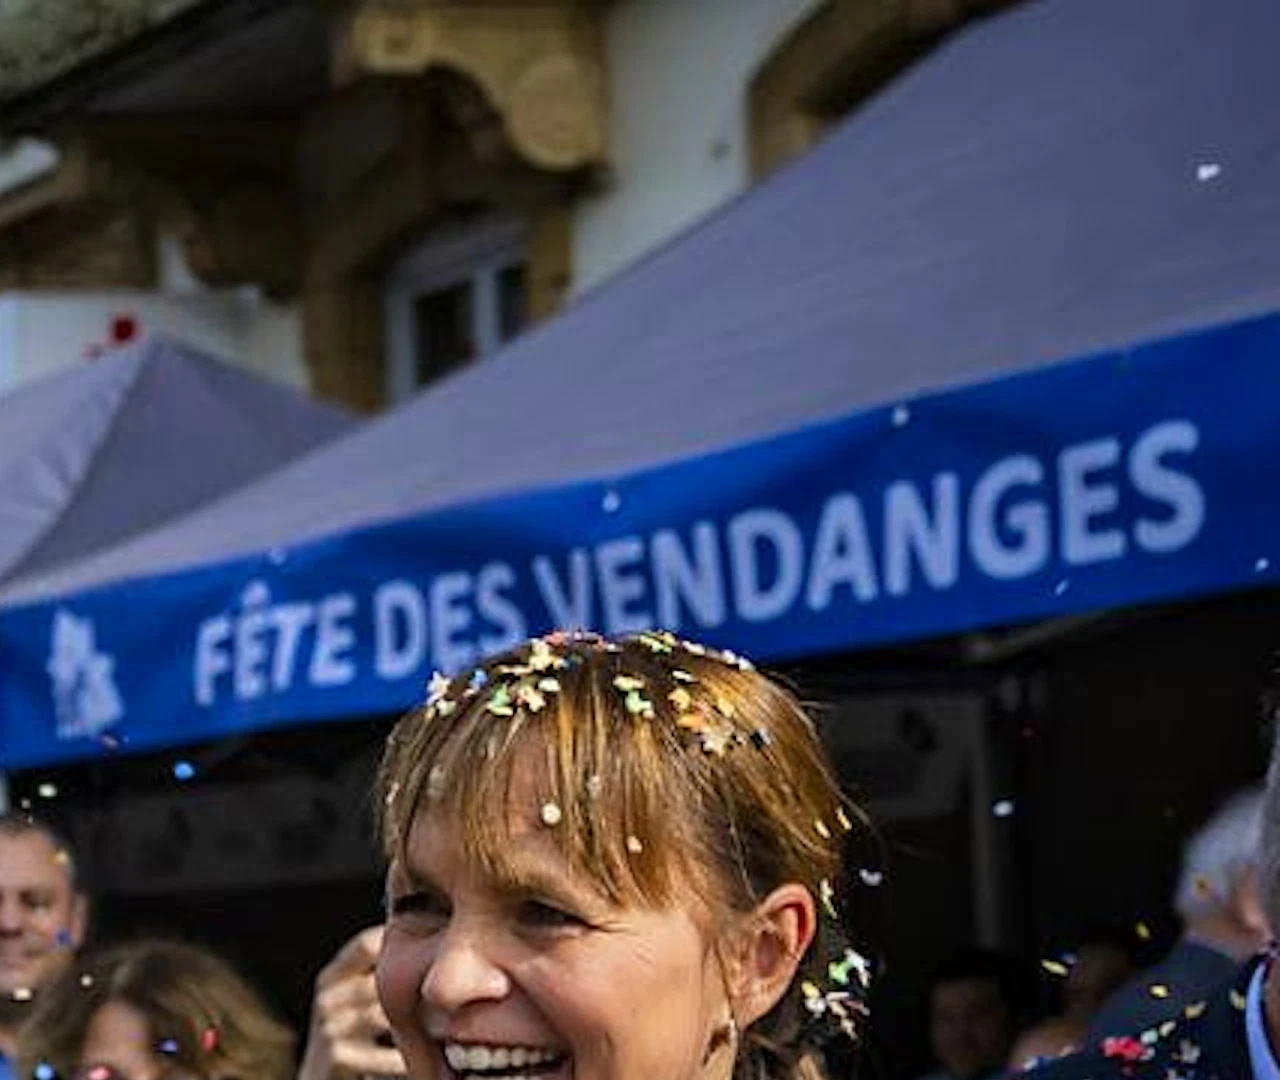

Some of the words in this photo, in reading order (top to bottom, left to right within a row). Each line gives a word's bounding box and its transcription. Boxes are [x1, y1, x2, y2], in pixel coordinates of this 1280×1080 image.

[195, 578, 358, 707] FÊTE
[372, 563, 528, 679] DES
[532, 420, 1205, 633] VENDANGES
